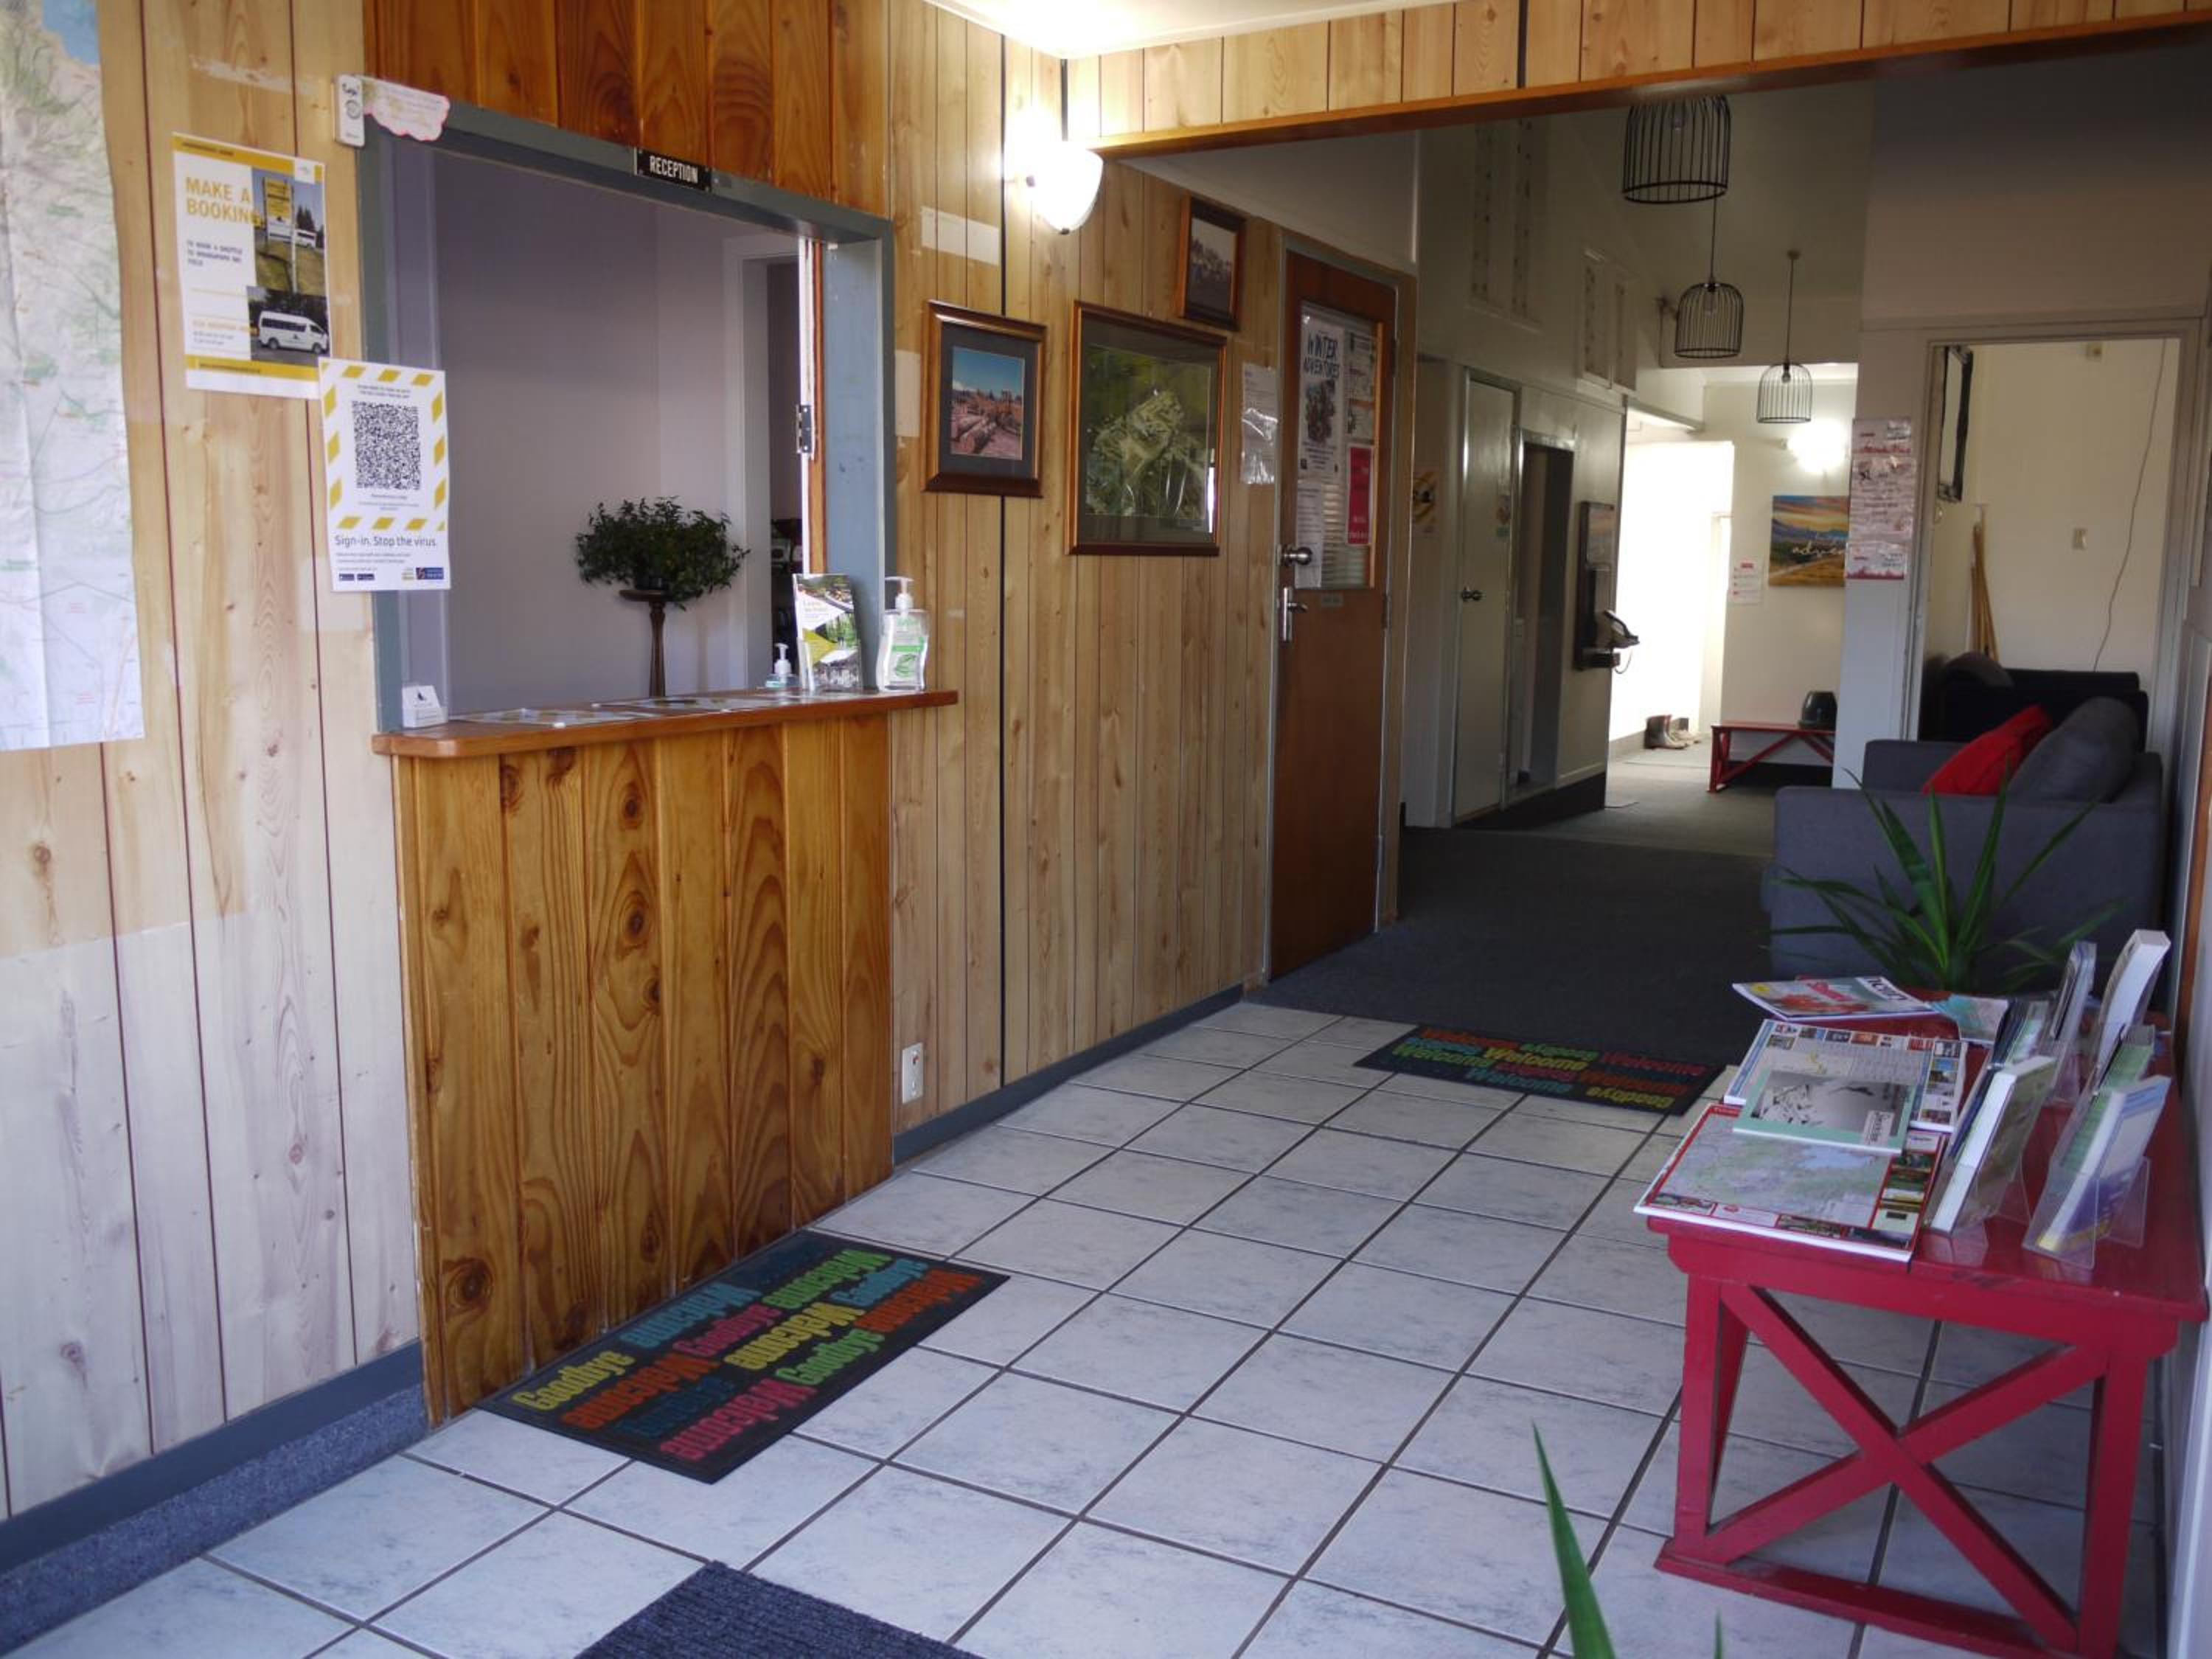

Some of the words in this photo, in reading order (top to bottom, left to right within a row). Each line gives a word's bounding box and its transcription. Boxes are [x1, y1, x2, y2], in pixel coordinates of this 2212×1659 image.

[186, 177, 233, 201] MAKE
[241, 187, 251, 203] A
[650, 155, 698, 184] RECEPTION
[373, 535, 395, 547] Stop
[397, 535, 412, 546] the
[1393, 1043, 1495, 1069] Welcome
[1484, 1048, 1589, 1070] Welcome
[762, 1249, 891, 1308] Welcome
[620, 1281, 763, 1349] Welcome
[724, 1301, 864, 1369] Welcome
[512, 1350, 635, 1409] Goodbye
[776, 1328, 886, 1385] Goodbye
[559, 1352, 720, 1430] Welcome
[661, 1377, 817, 1461] Welcome
